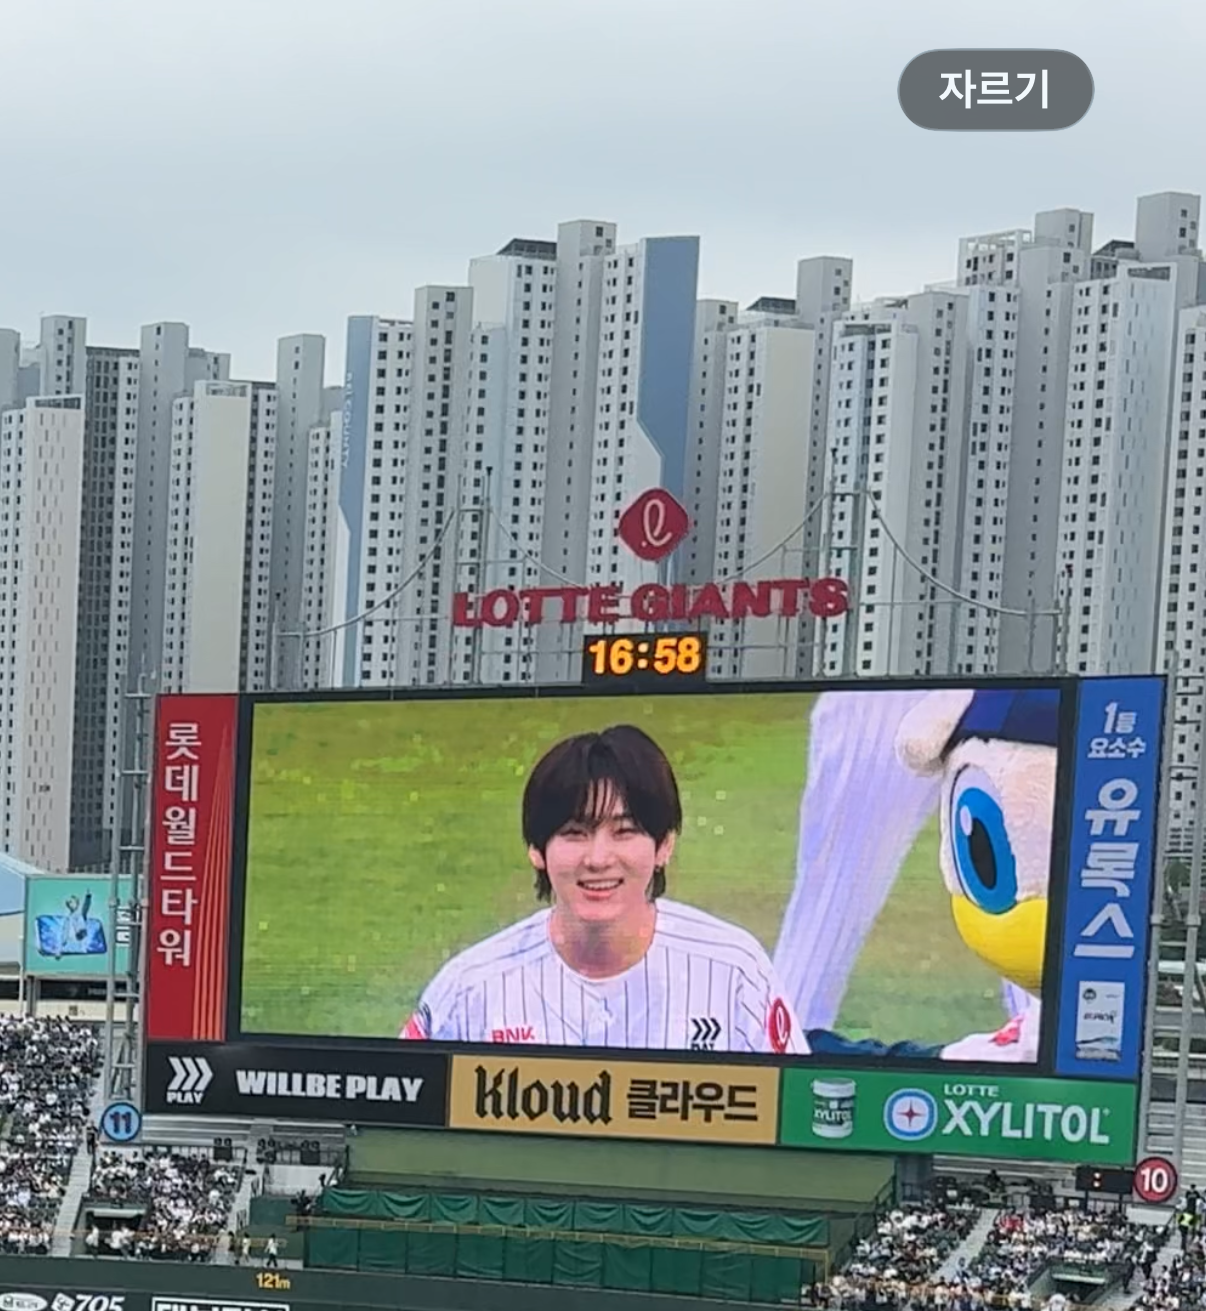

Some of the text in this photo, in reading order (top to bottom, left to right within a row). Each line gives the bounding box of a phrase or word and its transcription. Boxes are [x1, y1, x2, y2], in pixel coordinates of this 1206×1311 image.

[452, 577, 849, 628] LOTTE GIANTS
[588, 636, 702, 675] 16:58
[1104, 702, 1137, 733] 1등
[1087, 737, 1146, 758] 요소수
[157, 722, 202, 966] 롯데월드타워
[1074, 778, 1140, 958] 유록스
[166, 1091, 204, 1104] PLAY
[236, 1069, 424, 1102] WILLBE PLAY
[474, 1064, 613, 1125] Kloud
[627, 1078, 758, 1123] 클라우드
[944, 1083, 999, 1097] LOTTE
[109, 1111, 132, 1134] 11
[941, 1099, 1110, 1144] XYLITOL
[1140, 1167, 1169, 1194] 10
[256, 1272, 291, 1289] 121m
